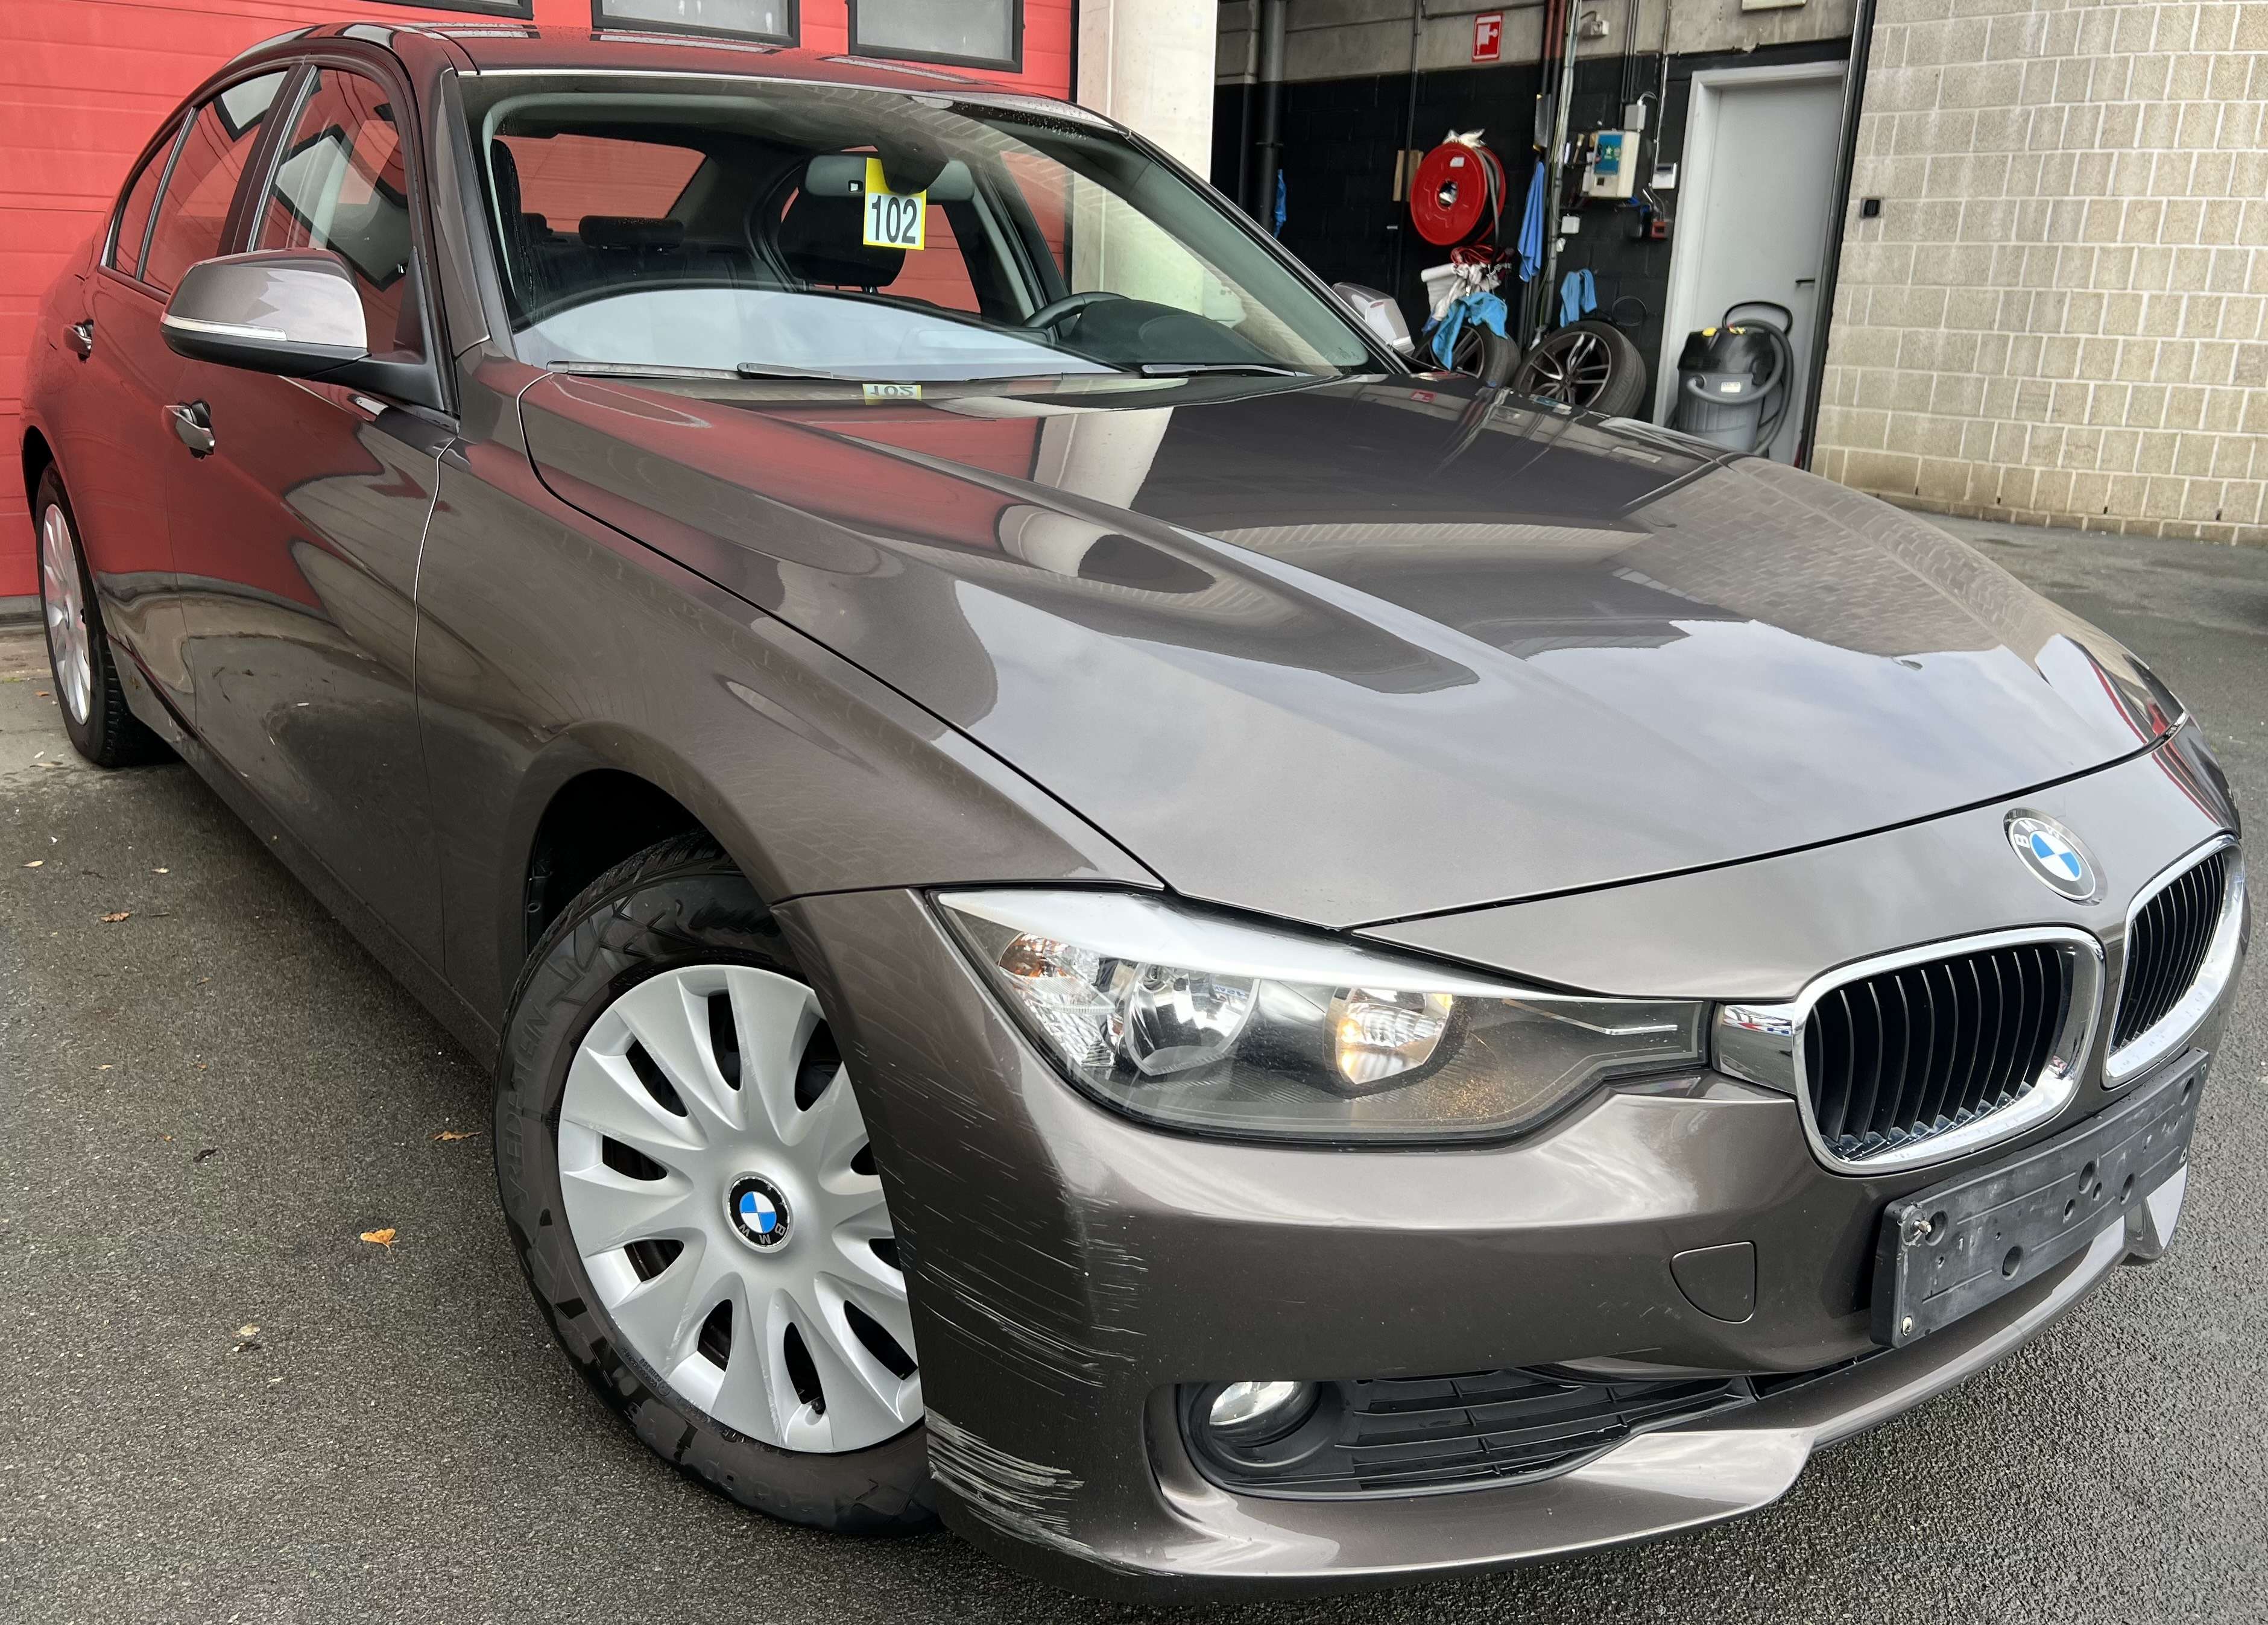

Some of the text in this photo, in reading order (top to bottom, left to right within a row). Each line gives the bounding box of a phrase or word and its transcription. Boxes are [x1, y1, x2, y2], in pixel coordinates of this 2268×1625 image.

[871, 195, 917, 244] 102
[2014, 819, 2060, 848] BMW
[739, 1222, 786, 1245] BMW
